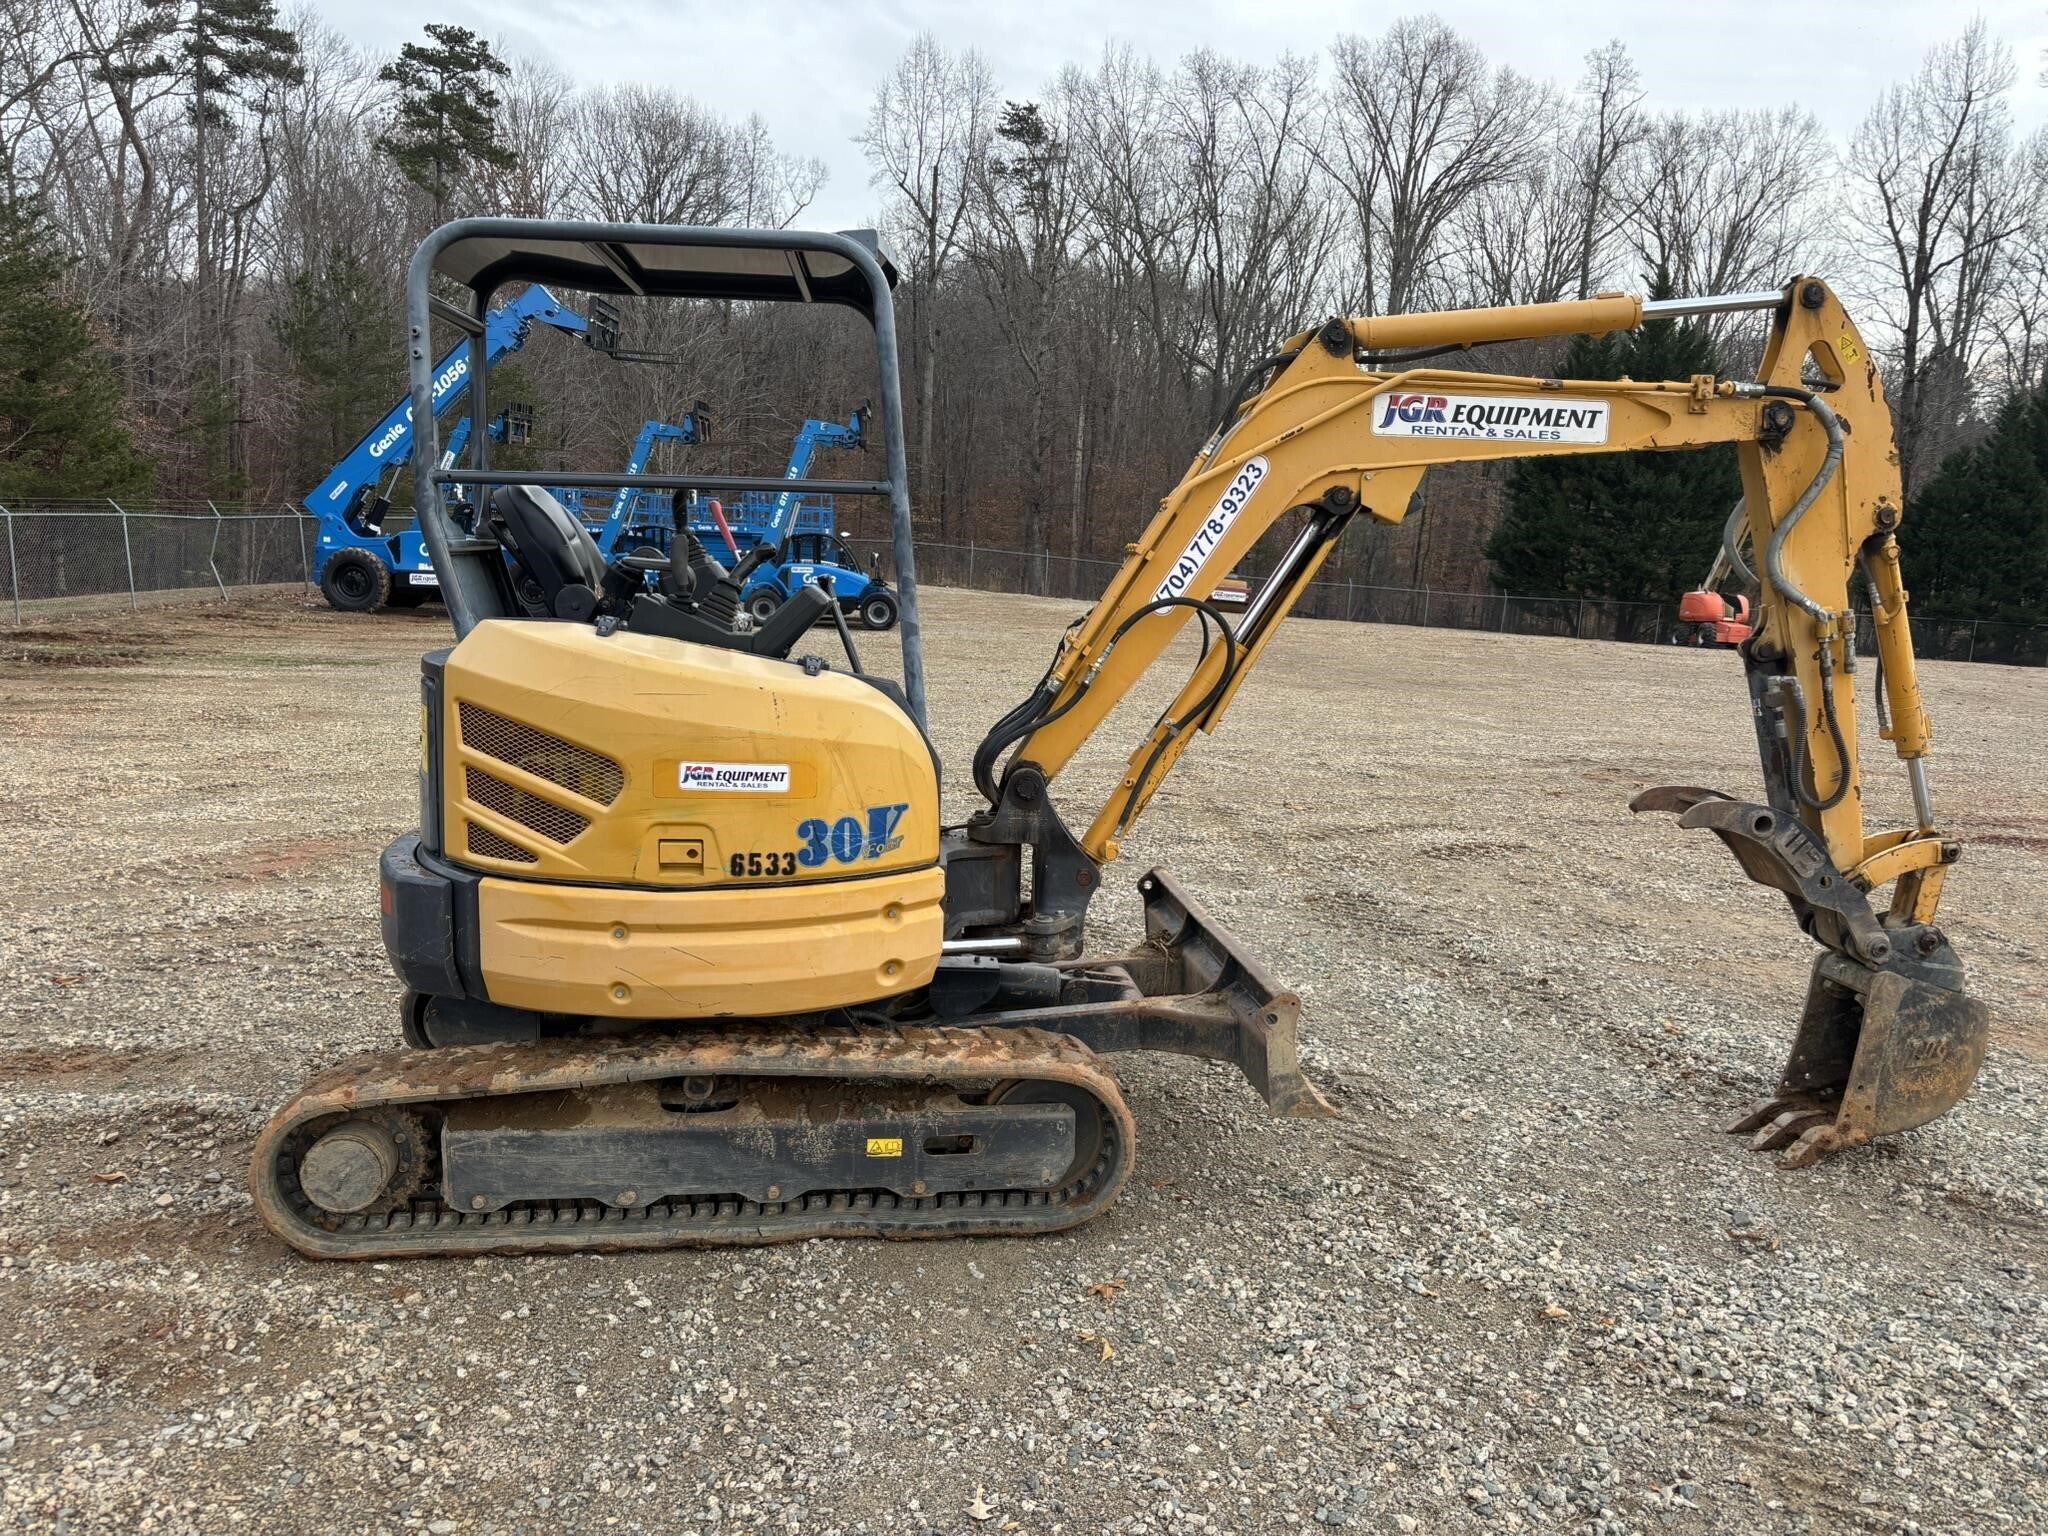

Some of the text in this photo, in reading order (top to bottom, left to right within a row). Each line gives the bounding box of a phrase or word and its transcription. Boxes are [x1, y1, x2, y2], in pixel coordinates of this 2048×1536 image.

[1379, 394, 1603, 430] JGR EQUIPMENT
[369, 423, 407, 457] Genie
[1411, 425, 1561, 440] RENTAL & SALES
[1190, 463, 1263, 557] 778-9323
[802, 573, 837, 584] Gee
[681, 765, 787, 784] JGR EQUIPMENT
[730, 852, 797, 877] 6533
